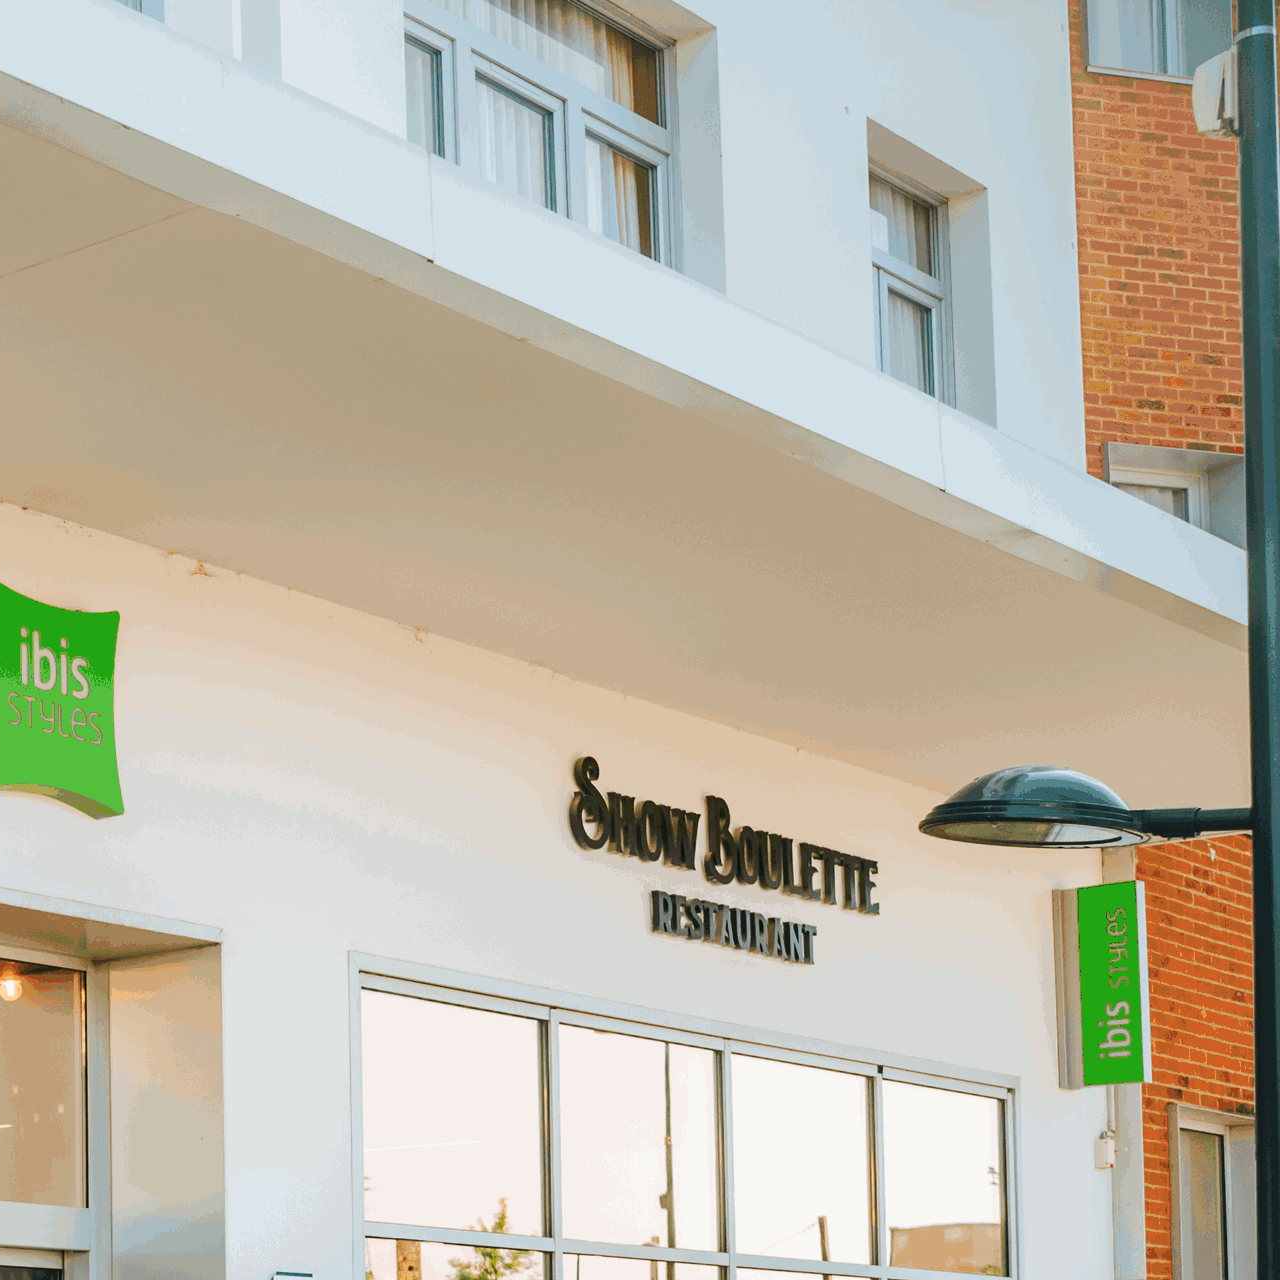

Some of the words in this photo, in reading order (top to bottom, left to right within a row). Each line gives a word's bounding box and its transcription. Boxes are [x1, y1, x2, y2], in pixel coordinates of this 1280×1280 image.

[20, 626, 91, 700] ibis
[704, 795, 880, 915] BOULETTE
[650, 890, 818, 965] RESTAURANT
[1098, 999, 1133, 1060] ibis
